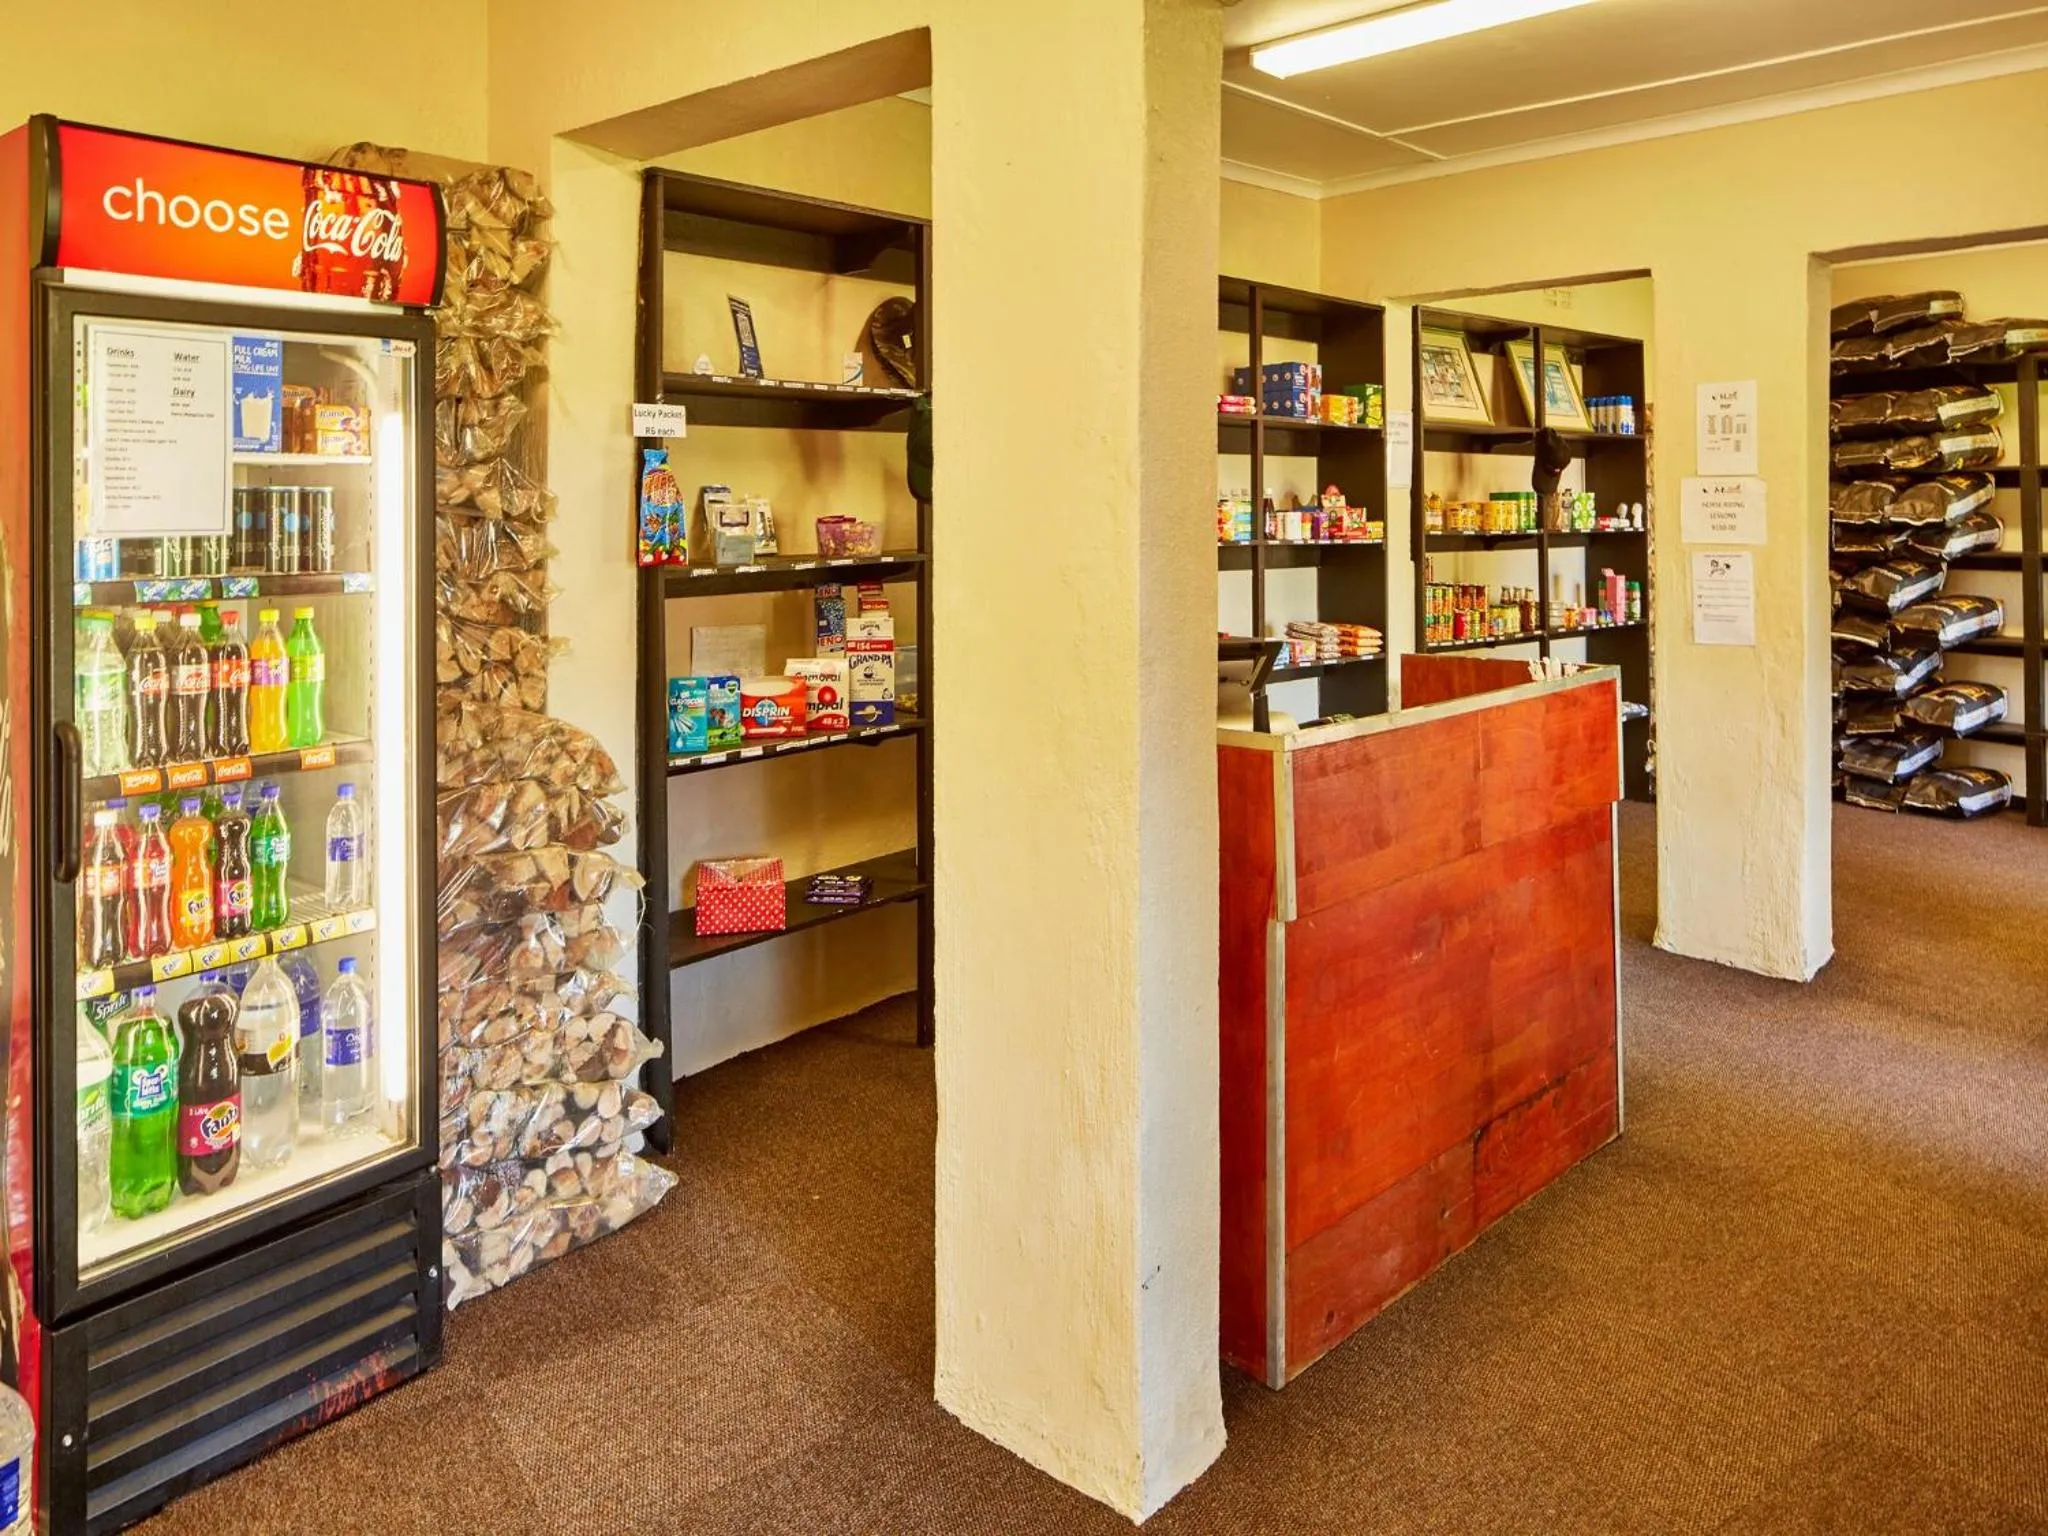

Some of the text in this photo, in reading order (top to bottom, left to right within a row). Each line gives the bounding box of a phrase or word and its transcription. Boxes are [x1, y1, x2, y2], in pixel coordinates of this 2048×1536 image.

[102, 177, 289, 240] choose
[303, 199, 404, 262] Coca-Cola
[106, 346, 135, 358] Drinks
[174, 352, 200, 363] Water
[234, 345, 278, 358] FULL CREAM
[172, 387, 196, 399] Dairy
[634, 408, 656, 419] Lucky
[657, 427, 676, 436] each
[818, 636, 843, 647] ENO
[849, 653, 893, 670] GRAND-PA
[742, 705, 791, 718] DISPRIN
